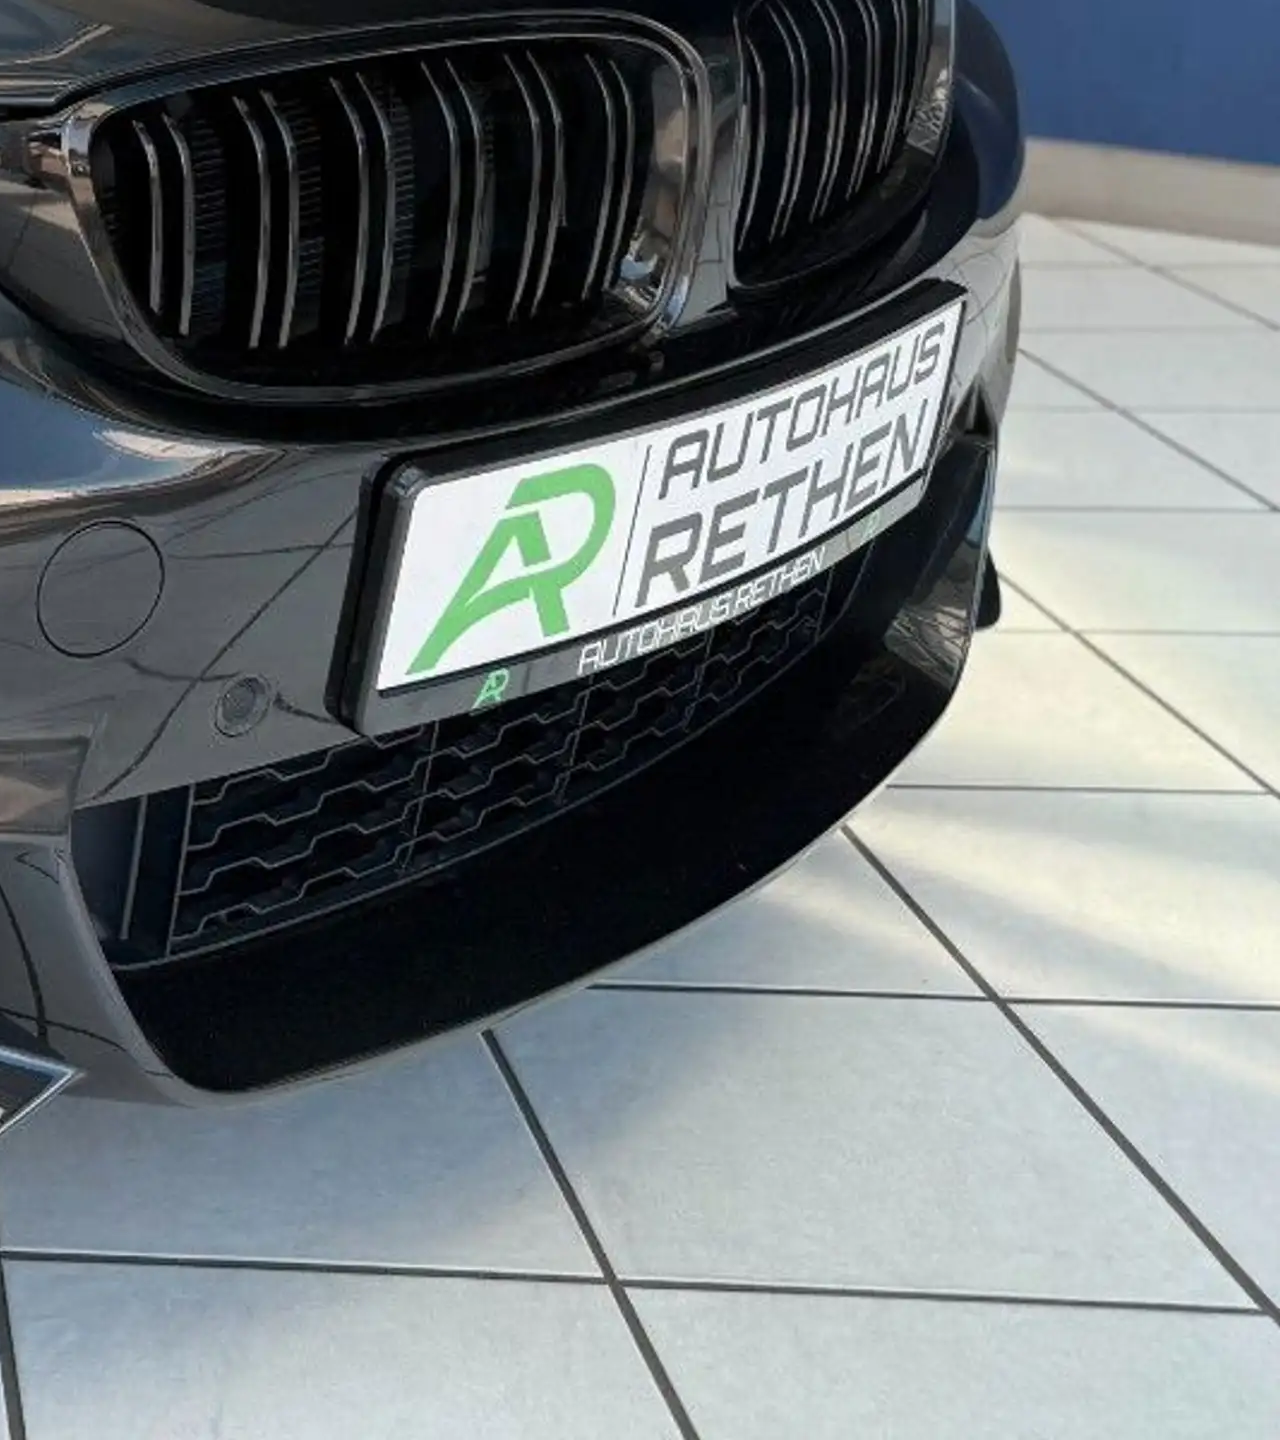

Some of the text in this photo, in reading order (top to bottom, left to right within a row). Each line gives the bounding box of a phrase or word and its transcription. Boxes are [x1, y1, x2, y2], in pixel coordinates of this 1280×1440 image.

[634, 397, 928, 609] RETHEN
[658, 321, 945, 500] AUTOHAUS
[405, 462, 617, 675] AR
[576, 545, 827, 676] AUTOHAUS RETHEN
